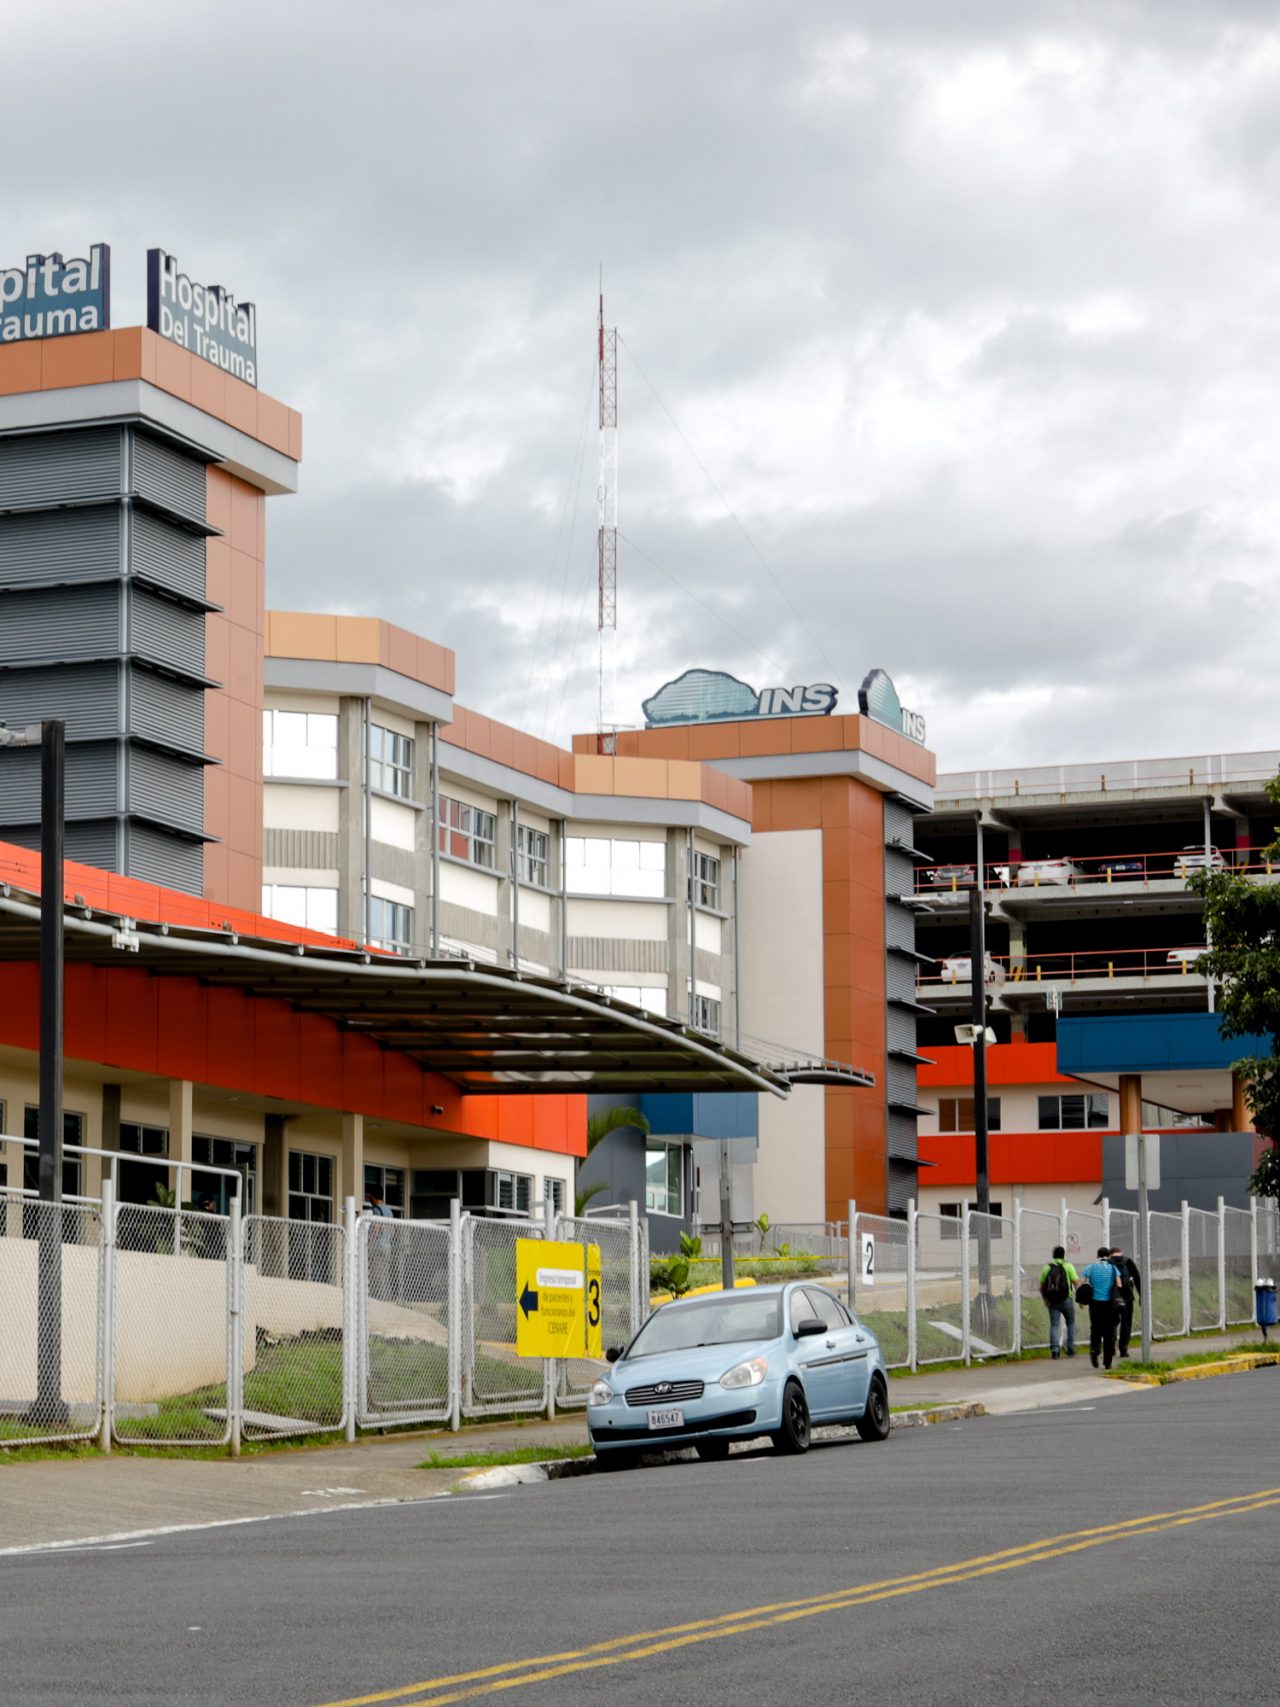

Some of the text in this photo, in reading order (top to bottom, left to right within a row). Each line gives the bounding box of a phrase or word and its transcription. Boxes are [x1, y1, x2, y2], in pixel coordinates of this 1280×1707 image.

[159, 250, 255, 348] Hospital
[159, 306, 256, 384] Del Trauma
[759, 683, 834, 714] INS
[902, 708, 926, 742] INS
[866, 1241, 874, 1275] 2
[588, 1279, 600, 1327] 3
